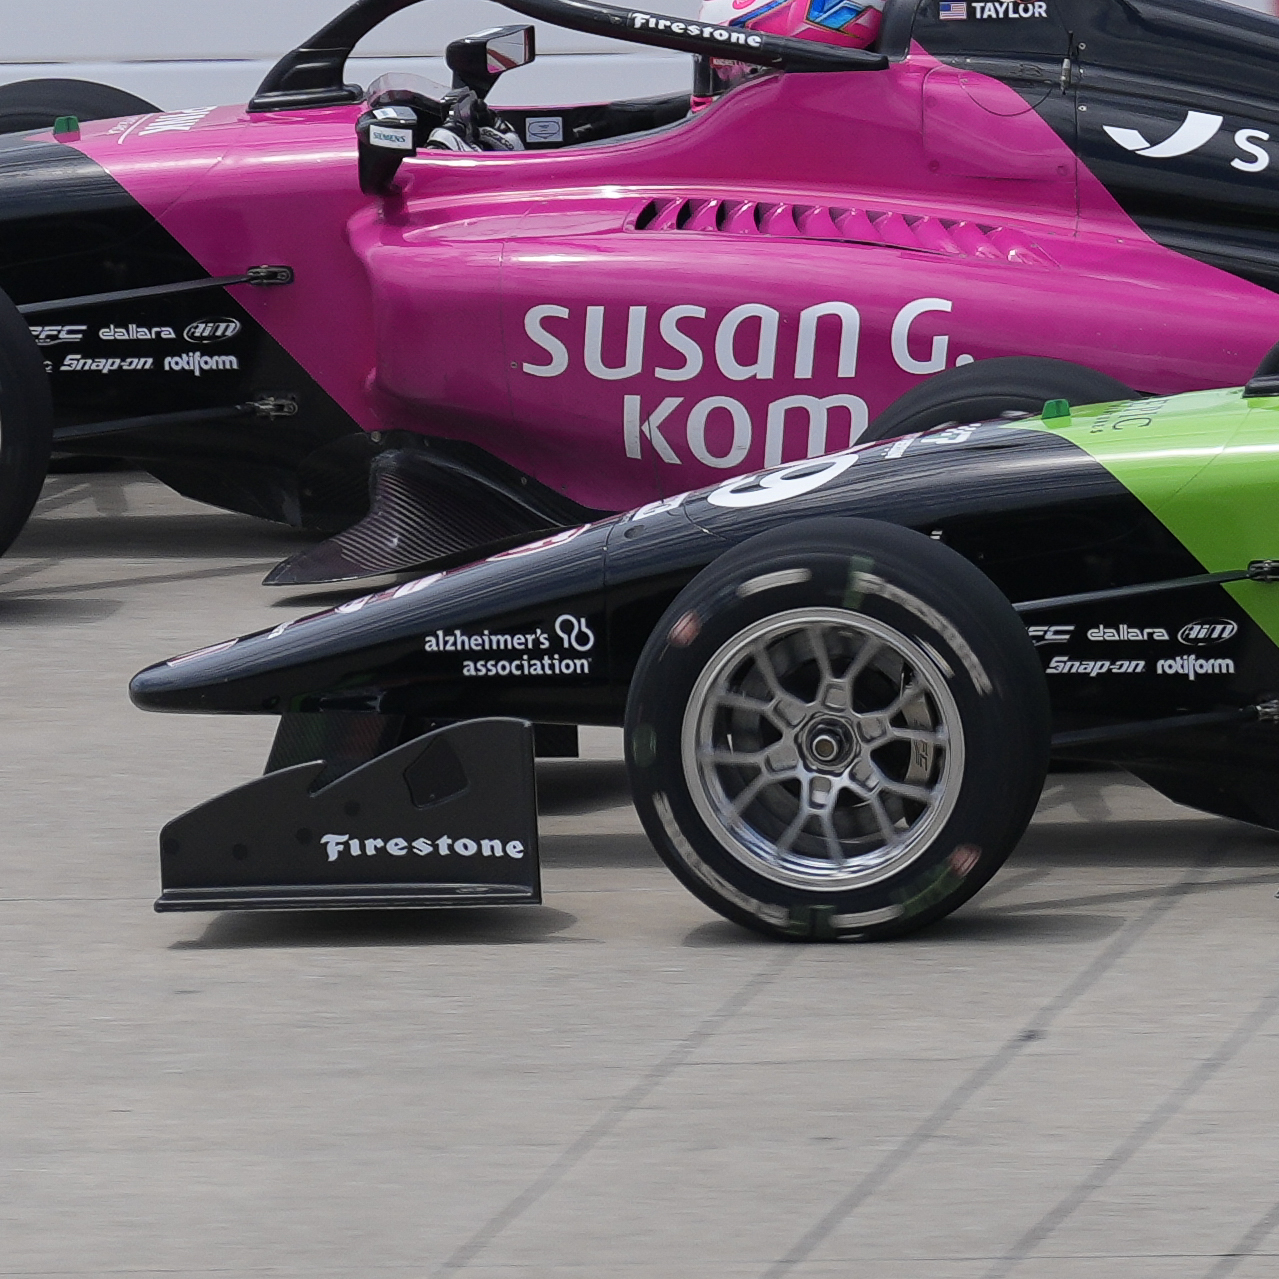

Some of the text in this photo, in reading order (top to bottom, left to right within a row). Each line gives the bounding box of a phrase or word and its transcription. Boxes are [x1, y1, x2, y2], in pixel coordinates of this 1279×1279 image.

[972, 2, 1048, 19] TAYLOR
[631, 12, 763, 48] Firestone
[372, 130, 406, 144] SIEMENS
[98, 324, 177, 340] dallara
[891, 297, 976, 376] G.
[60, 354, 154, 374] Snap-on
[163, 351, 240, 377] rotiform
[706, 453, 860, 508] 9
[1028, 624, 1075, 640] FC
[1087, 624, 1169, 641] dallara
[462, 656, 591, 677] association
[1046, 654, 1235, 681] Snap-on rotiform
[321, 833, 524, 862] Firestone
